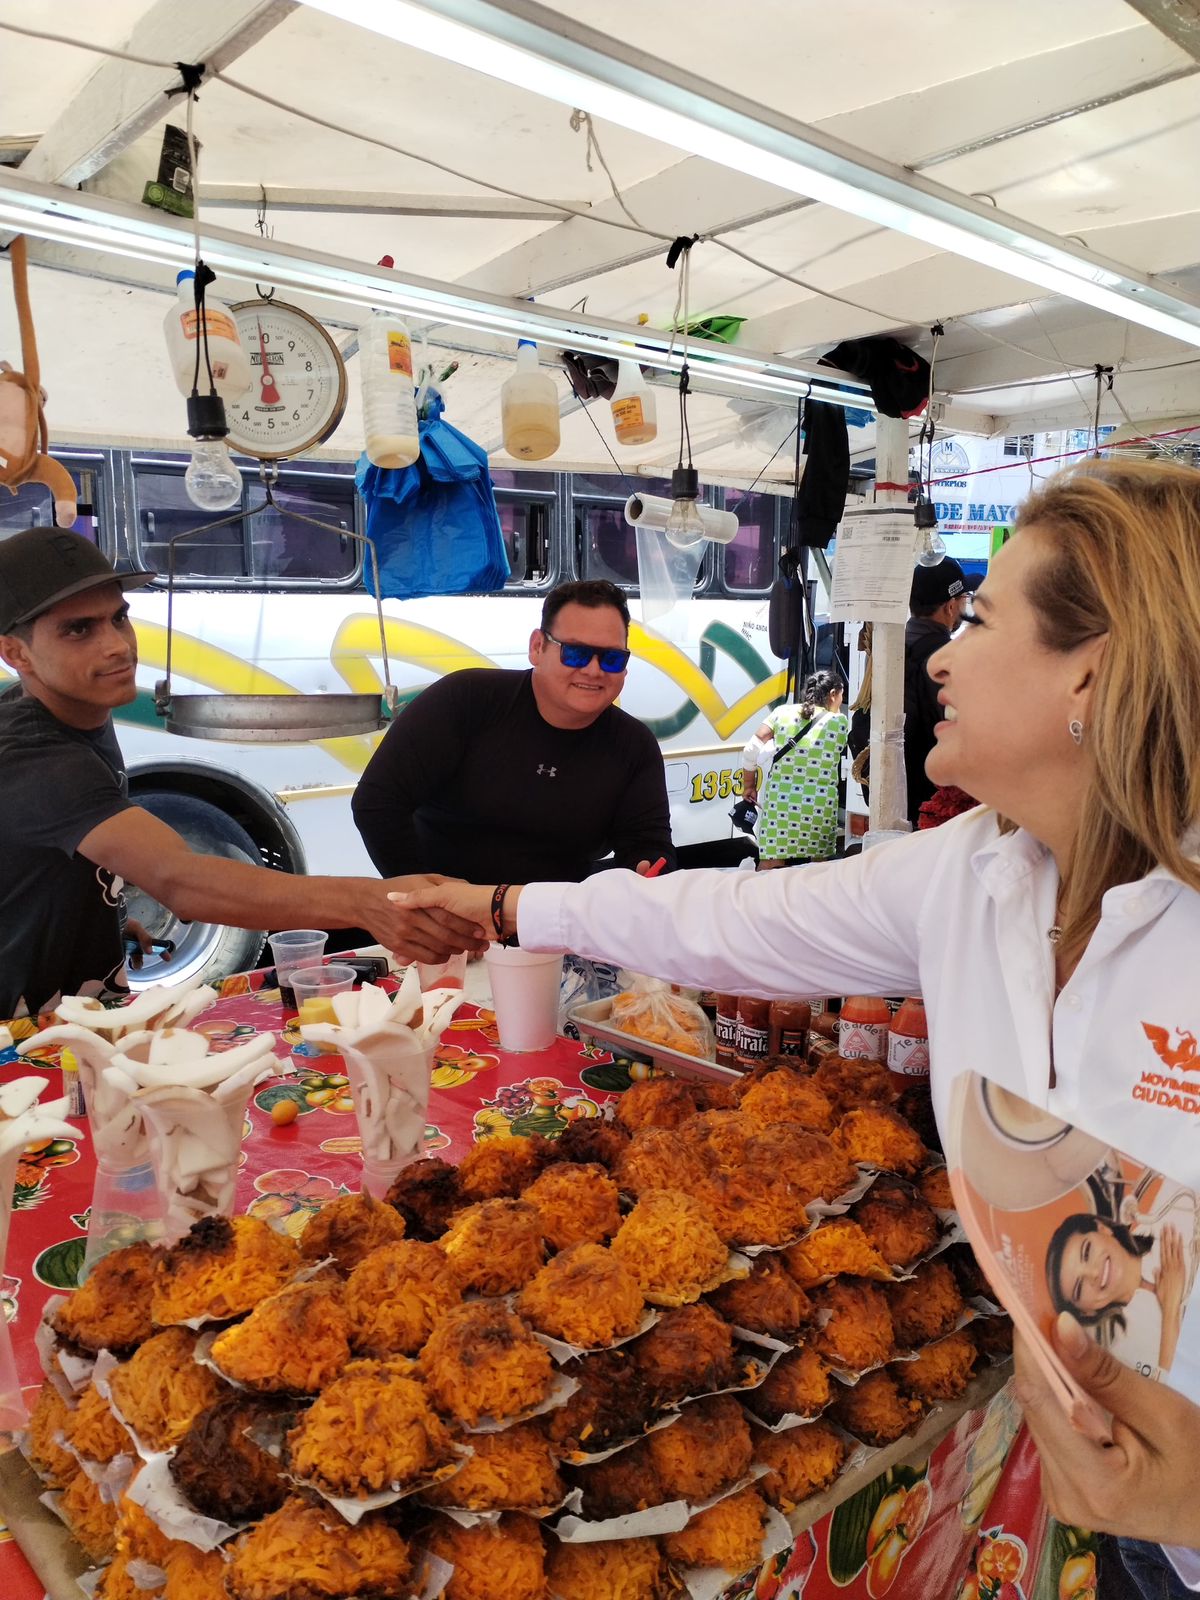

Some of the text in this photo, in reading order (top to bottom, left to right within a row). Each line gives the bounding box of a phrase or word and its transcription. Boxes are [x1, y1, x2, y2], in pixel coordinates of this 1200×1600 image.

[288, 340, 295, 352] 9
[305, 361, 313, 372] 8
[308, 389, 314, 401] 7
[242, 410, 250, 422] 4
[292, 409, 300, 421] 6
[267, 418, 275, 429] 5
[945, 442, 953, 452] M
[935, 502, 963, 521] DE
[841, 1021, 878, 1036] Te arde
[897, 1039, 912, 1049] Te
